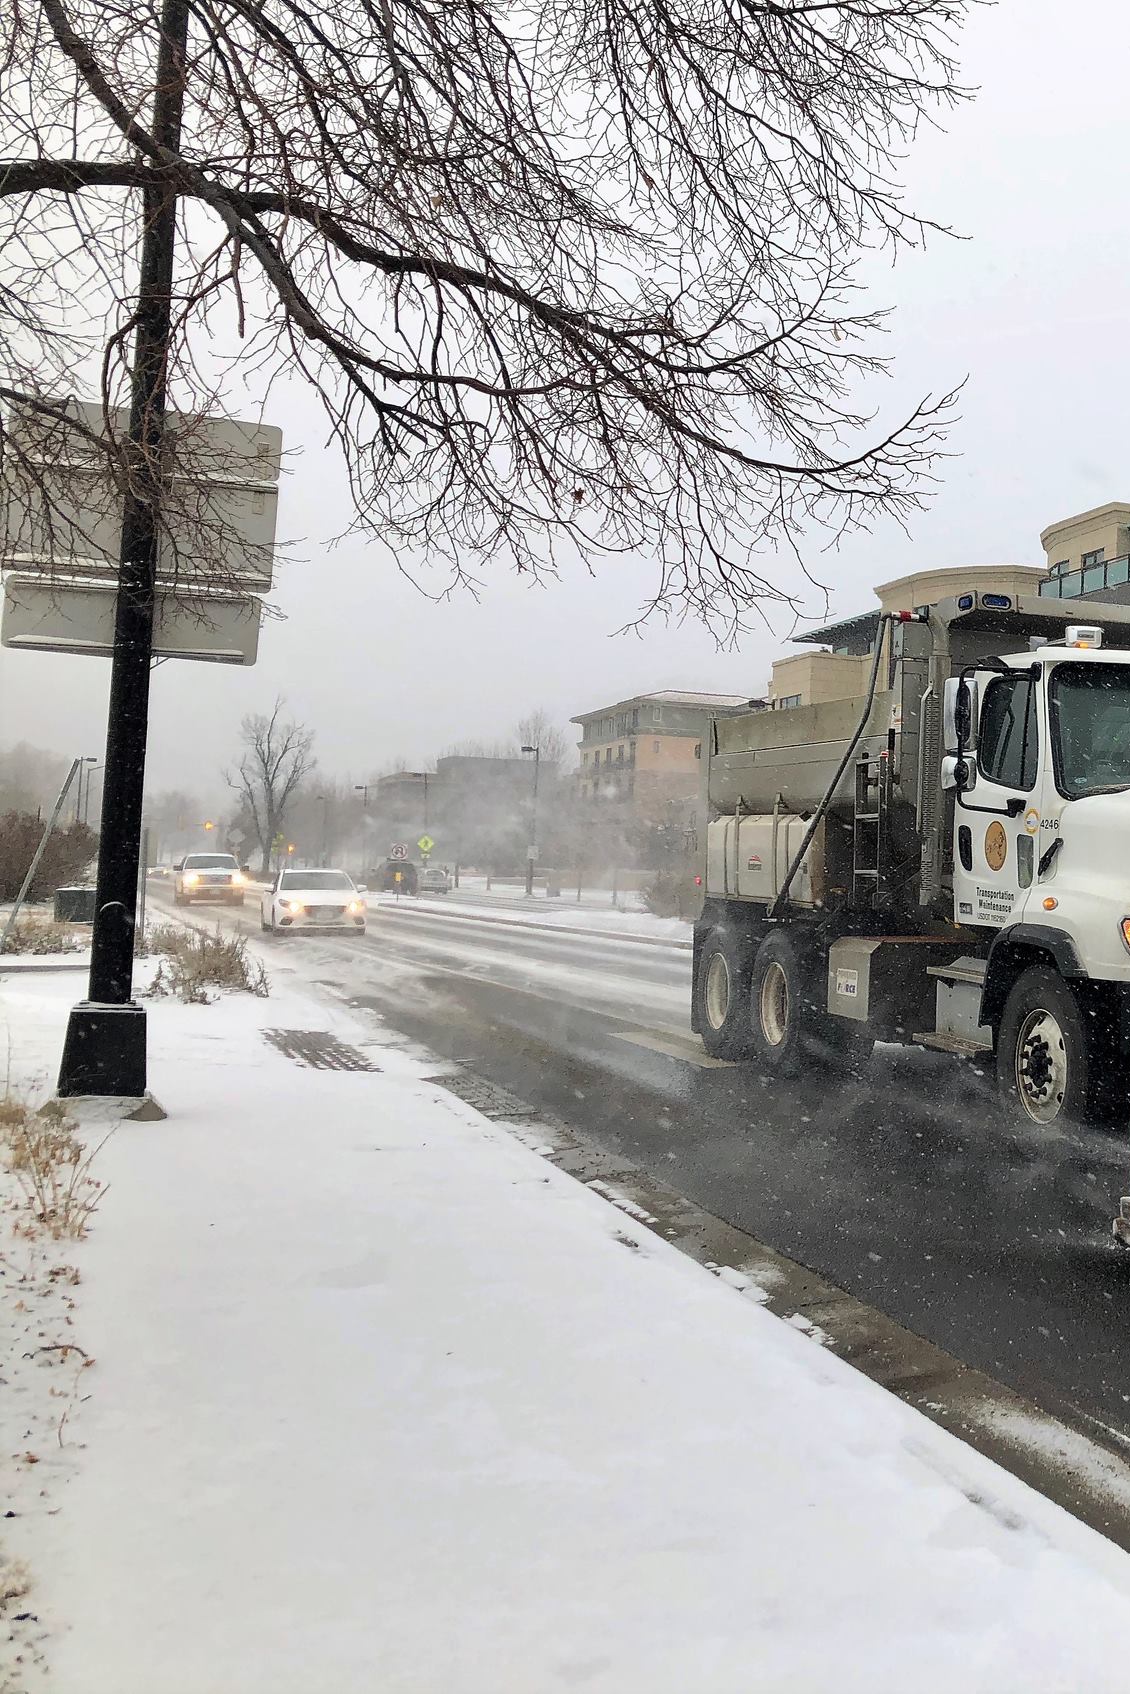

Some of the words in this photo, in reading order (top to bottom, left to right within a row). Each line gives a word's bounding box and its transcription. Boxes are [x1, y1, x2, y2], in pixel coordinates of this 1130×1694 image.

[1040, 819, 1059, 830] 4246
[976, 886, 1014, 901] Transportation
[978, 899, 1012, 913] Maintenance
